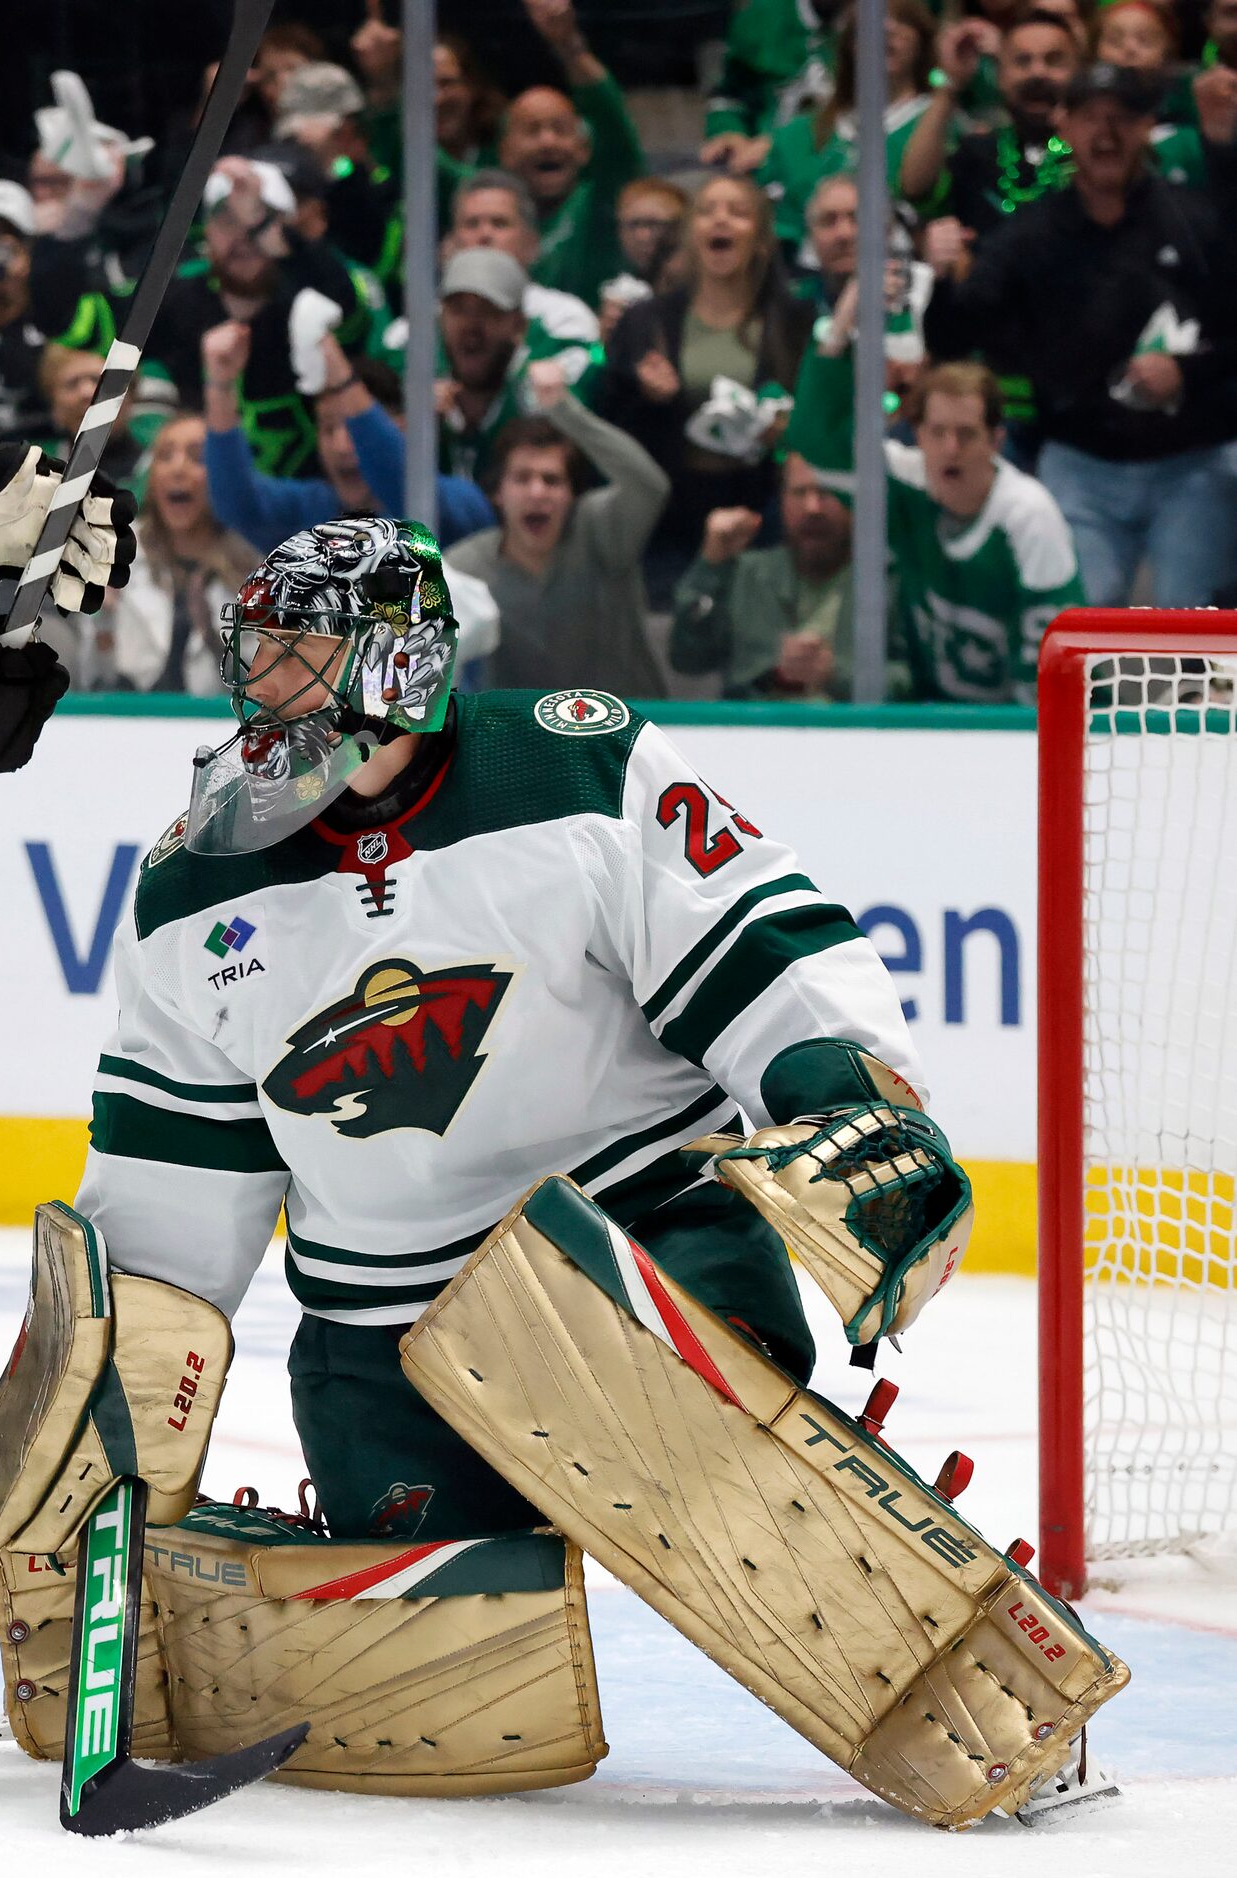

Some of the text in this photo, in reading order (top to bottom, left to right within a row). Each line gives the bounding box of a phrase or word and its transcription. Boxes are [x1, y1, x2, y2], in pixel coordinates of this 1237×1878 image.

[541, 691, 584, 730] MINNESOTA
[601, 708, 623, 727] WILD
[364, 840, 382, 858] NHL
[207, 957, 266, 991] TRIA
[167, 1350, 206, 1432] L20.2
[799, 1412, 978, 1569] TRUE
[143, 1543, 247, 1587] TRUE
[80, 1485, 127, 1758] TRUE
[1007, 1601, 1067, 1663] L20.2
